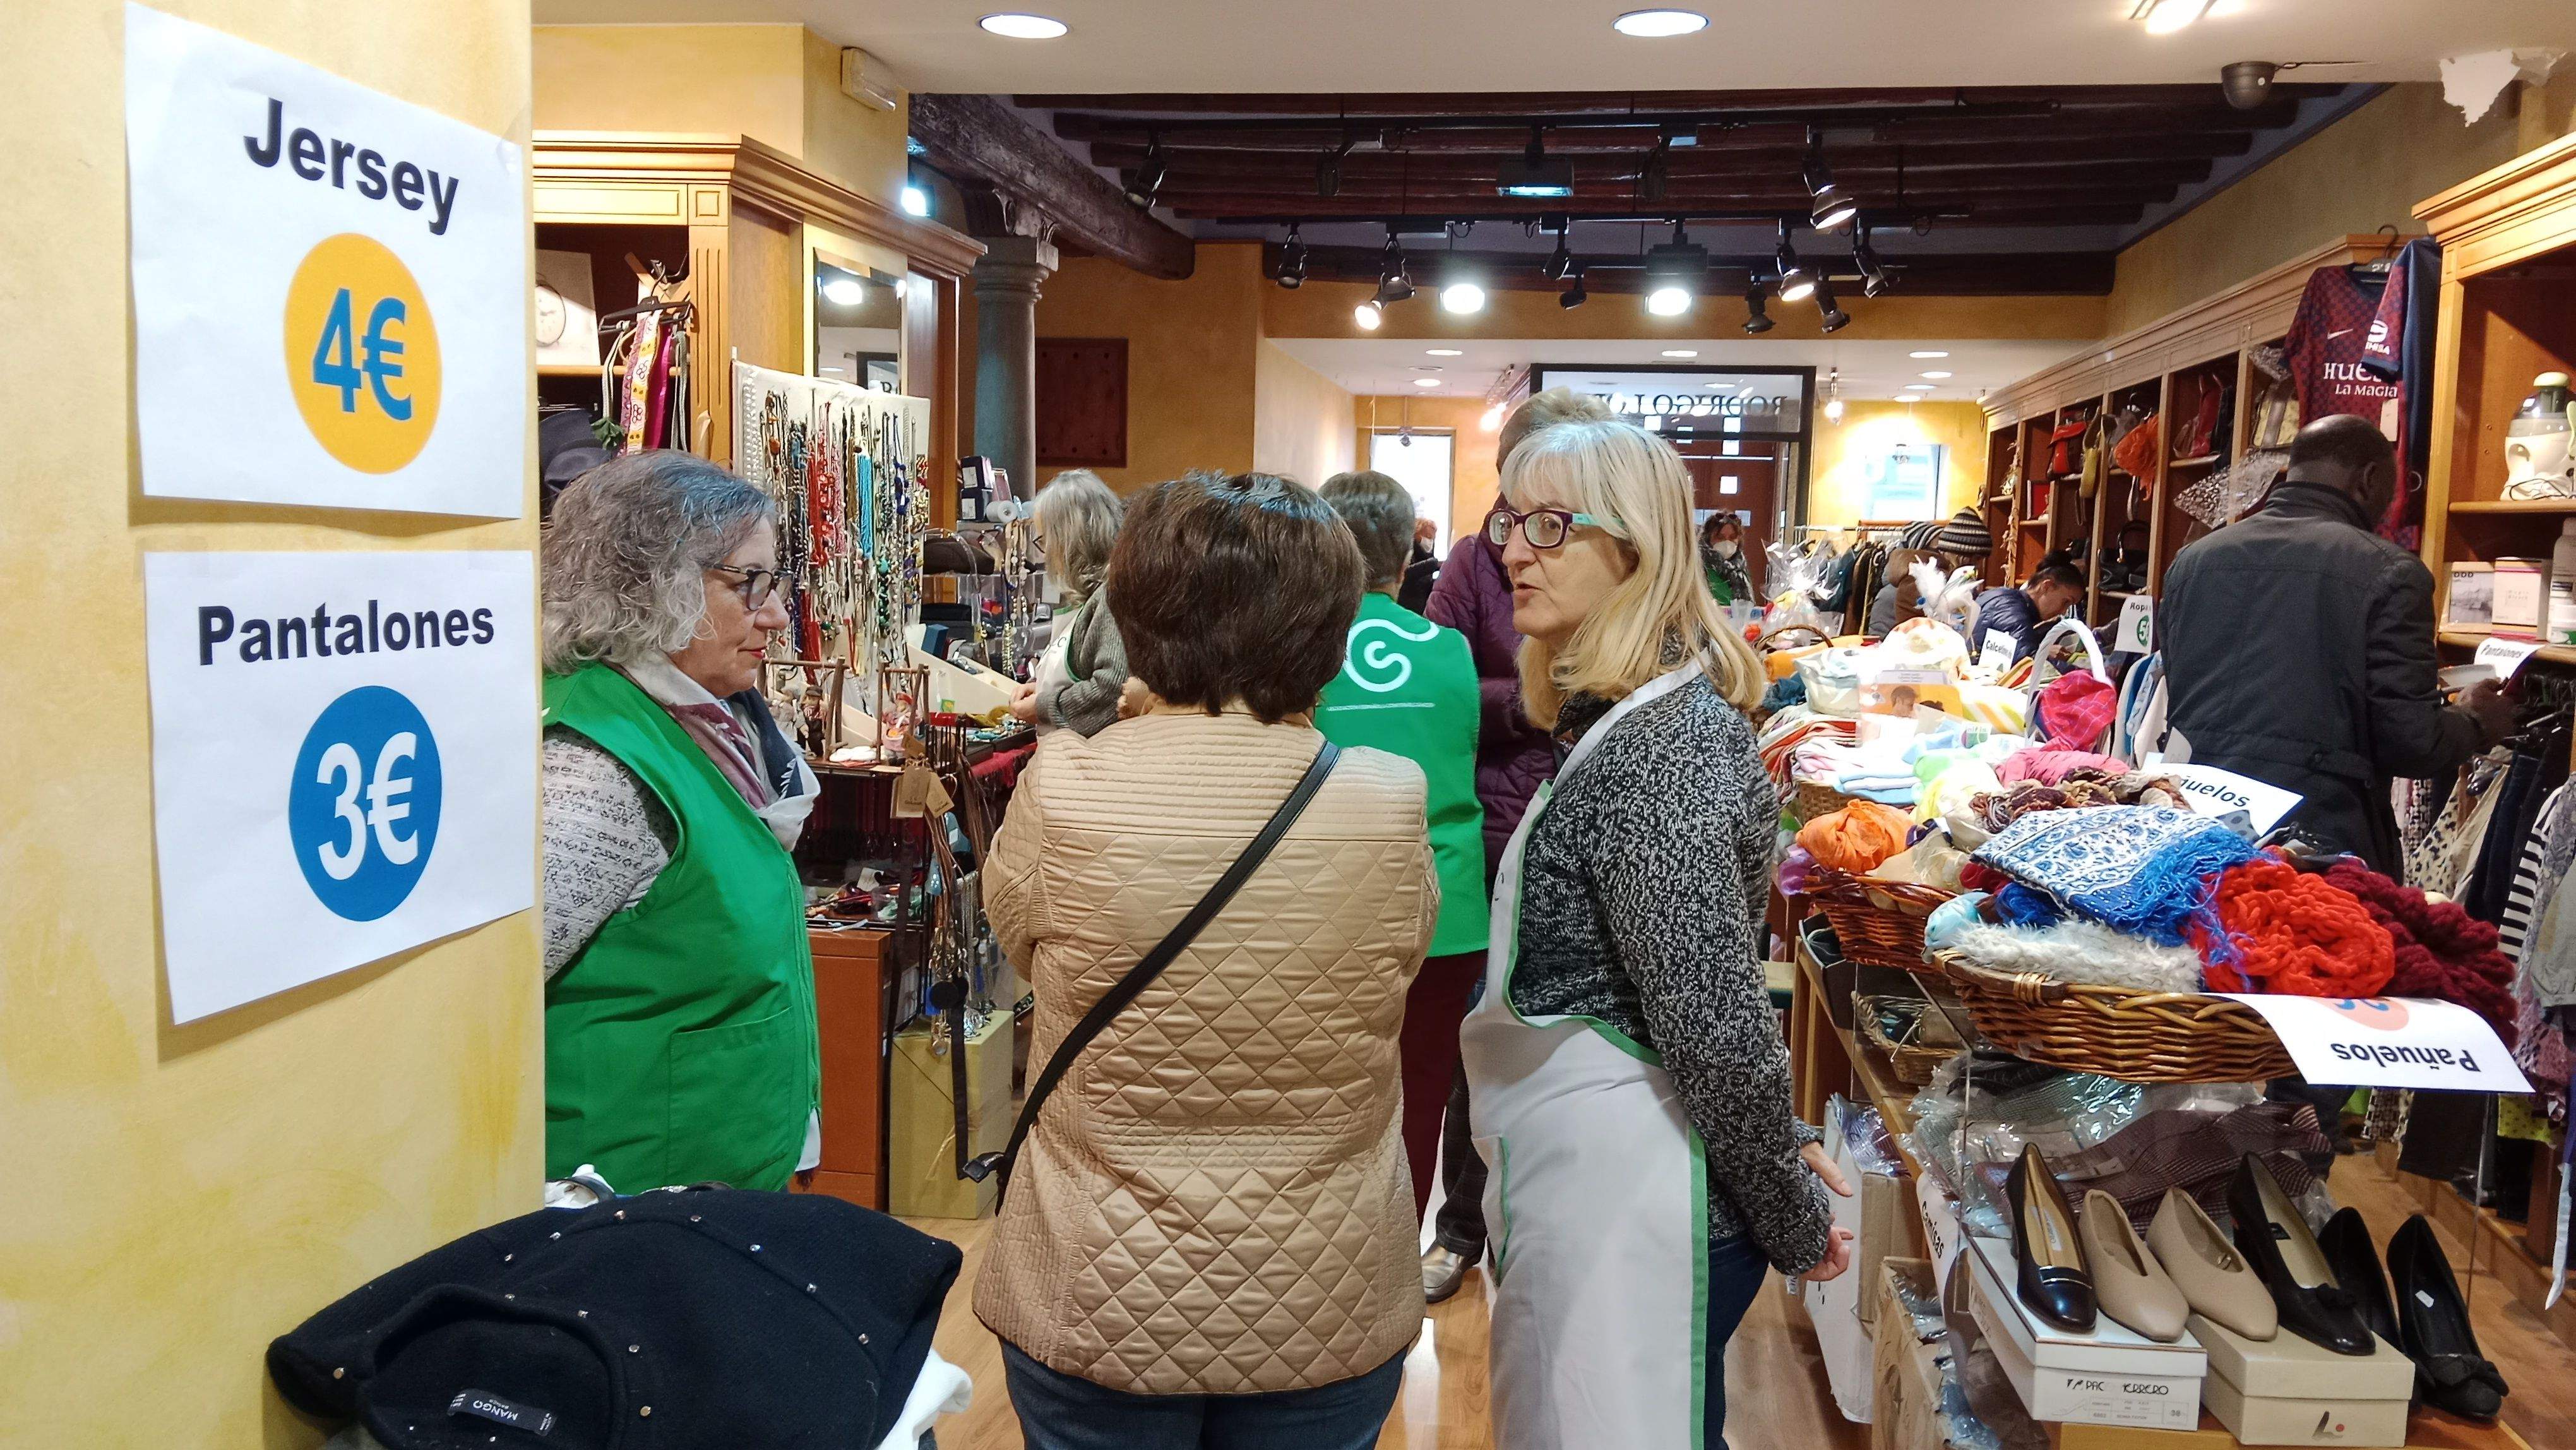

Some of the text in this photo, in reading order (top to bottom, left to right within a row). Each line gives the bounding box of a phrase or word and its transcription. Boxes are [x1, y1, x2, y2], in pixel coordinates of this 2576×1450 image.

[243, 97, 459, 236] Jersey
[313, 288, 412, 421] 4€
[2323, 362, 2382, 383] HUE
[198, 599, 494, 666] Pantalones
[2480, 644, 2525, 658] Pantalones
[316, 731, 419, 881] 3€
[2179, 775, 2250, 807] ñuelos
[2330, 1042, 2481, 1073] Pañuelos
[473, 1400, 518, 1421] MANGO
